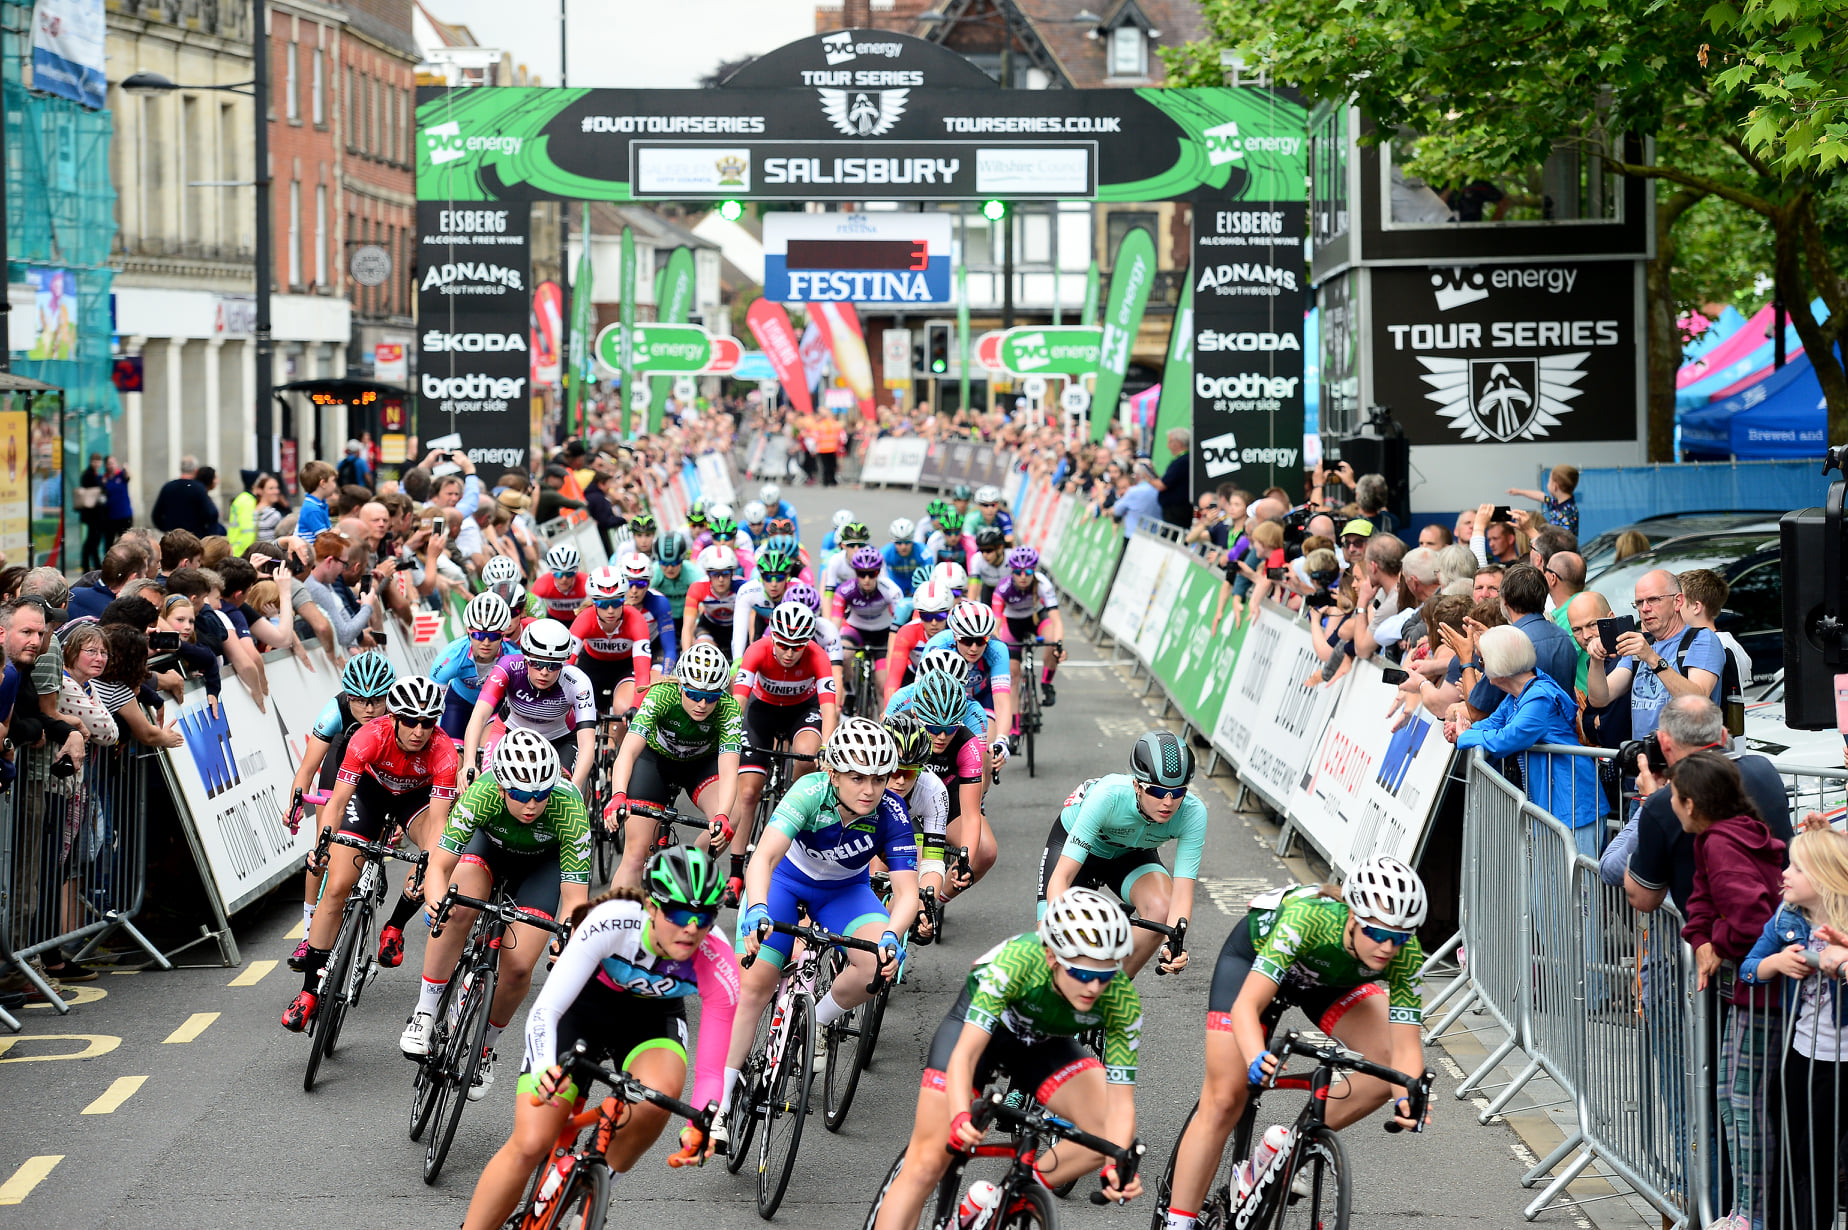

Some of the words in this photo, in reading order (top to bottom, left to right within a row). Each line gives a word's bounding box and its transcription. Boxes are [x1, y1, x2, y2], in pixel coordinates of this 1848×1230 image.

[855, 42, 902, 58] energy
[801, 71, 851, 86] TOUR
[855, 71, 924, 86] SERIES
[581, 116, 765, 133] #OVOTOURSERIES
[943, 116, 1121, 133] TOURSERIES.CO.UK
[466, 135, 523, 155] energy
[1245, 135, 1301, 155] energy
[764, 158, 960, 184] SALISBURY
[440, 210, 507, 233] EISBERG
[1216, 211, 1283, 234] EISBERG
[424, 235, 470, 245] ALCOHOL
[1199, 236, 1247, 246] ALCOHOL
[909, 240, 928, 271] 3
[421, 262, 522, 291] ADNAMS
[787, 272, 933, 301] FESTINA
[1196, 263, 1296, 293] ADNAMS
[1491, 268, 1577, 293] energy
[422, 330, 526, 352] ŠKODA
[1197, 329, 1300, 351] ŠKODA
[1387, 323, 1482, 350] TOUR
[1491, 320, 1618, 348] SERIES
[651, 343, 705, 362] energy
[1050, 345, 1101, 362] energ
[422, 373, 526, 399] brother
[1196, 373, 1299, 399] brother
[440, 400, 454, 412] at
[455, 402, 482, 415] your
[482, 400, 507, 412] side
[1213, 400, 1227, 411] at
[1228, 402, 1256, 414] your
[1256, 400, 1281, 411] side
[1748, 429, 1796, 441] Brewed
[1799, 429, 1824, 441] and
[467, 448, 524, 468] energy
[1241, 447, 1298, 468] energy
[593, 641, 628, 650] JUNIPER
[762, 682, 806, 695] JUNIPER
[882, 793, 910, 825] brother
[580, 919, 641, 941] JAKROO
[1390, 1009, 1417, 1022] COL
